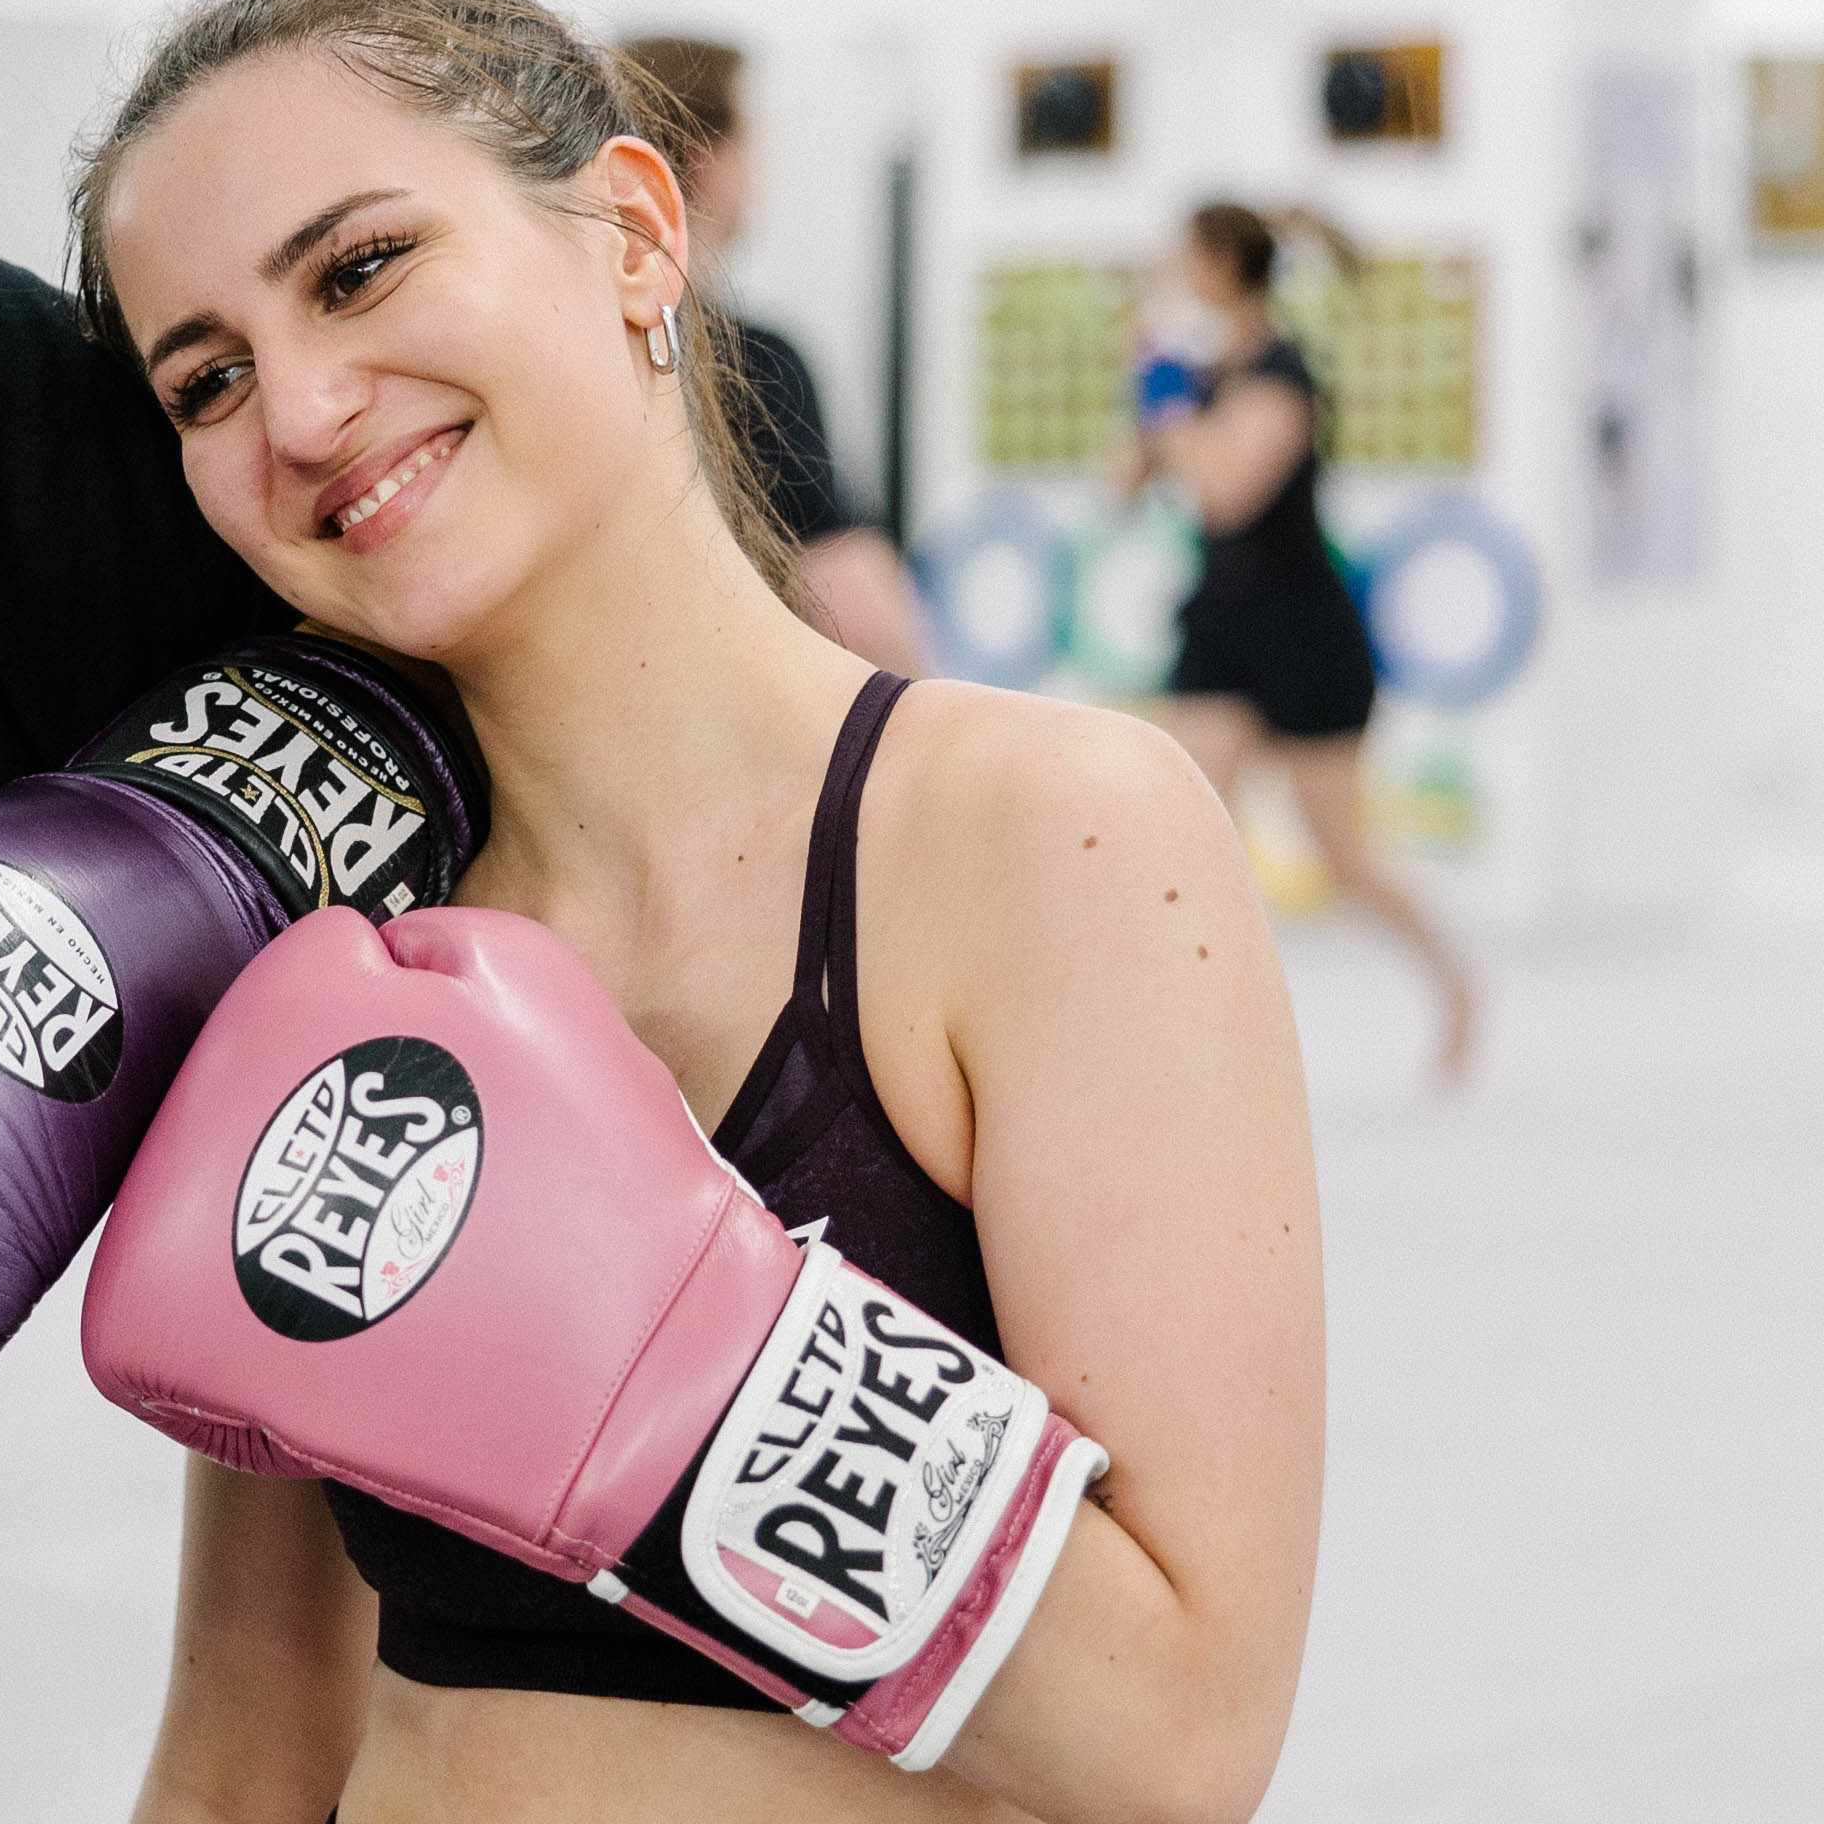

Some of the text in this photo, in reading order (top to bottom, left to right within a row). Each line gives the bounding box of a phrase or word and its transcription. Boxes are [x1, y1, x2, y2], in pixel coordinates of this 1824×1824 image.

[252, 669, 410, 792] PROFESIONAL
[254, 682, 388, 783] HECHO EN MEXICO
[150, 681, 427, 896] REYES
[154, 754, 316, 889] CLETO
[47, 917, 65, 934] EN
[68, 938, 105, 984] HECHO
[247, 1079, 335, 1226] CLETO
[260, 1071, 446, 1320] REYES
[390, 1178, 438, 1260] Girl
[424, 1202, 451, 1243] MEXICO
[735, 1300, 847, 1484] CLETO
[754, 1300, 975, 1624] REYES
[922, 1438, 966, 1522] Girl
[955, 1459, 984, 1505] MEXICO
